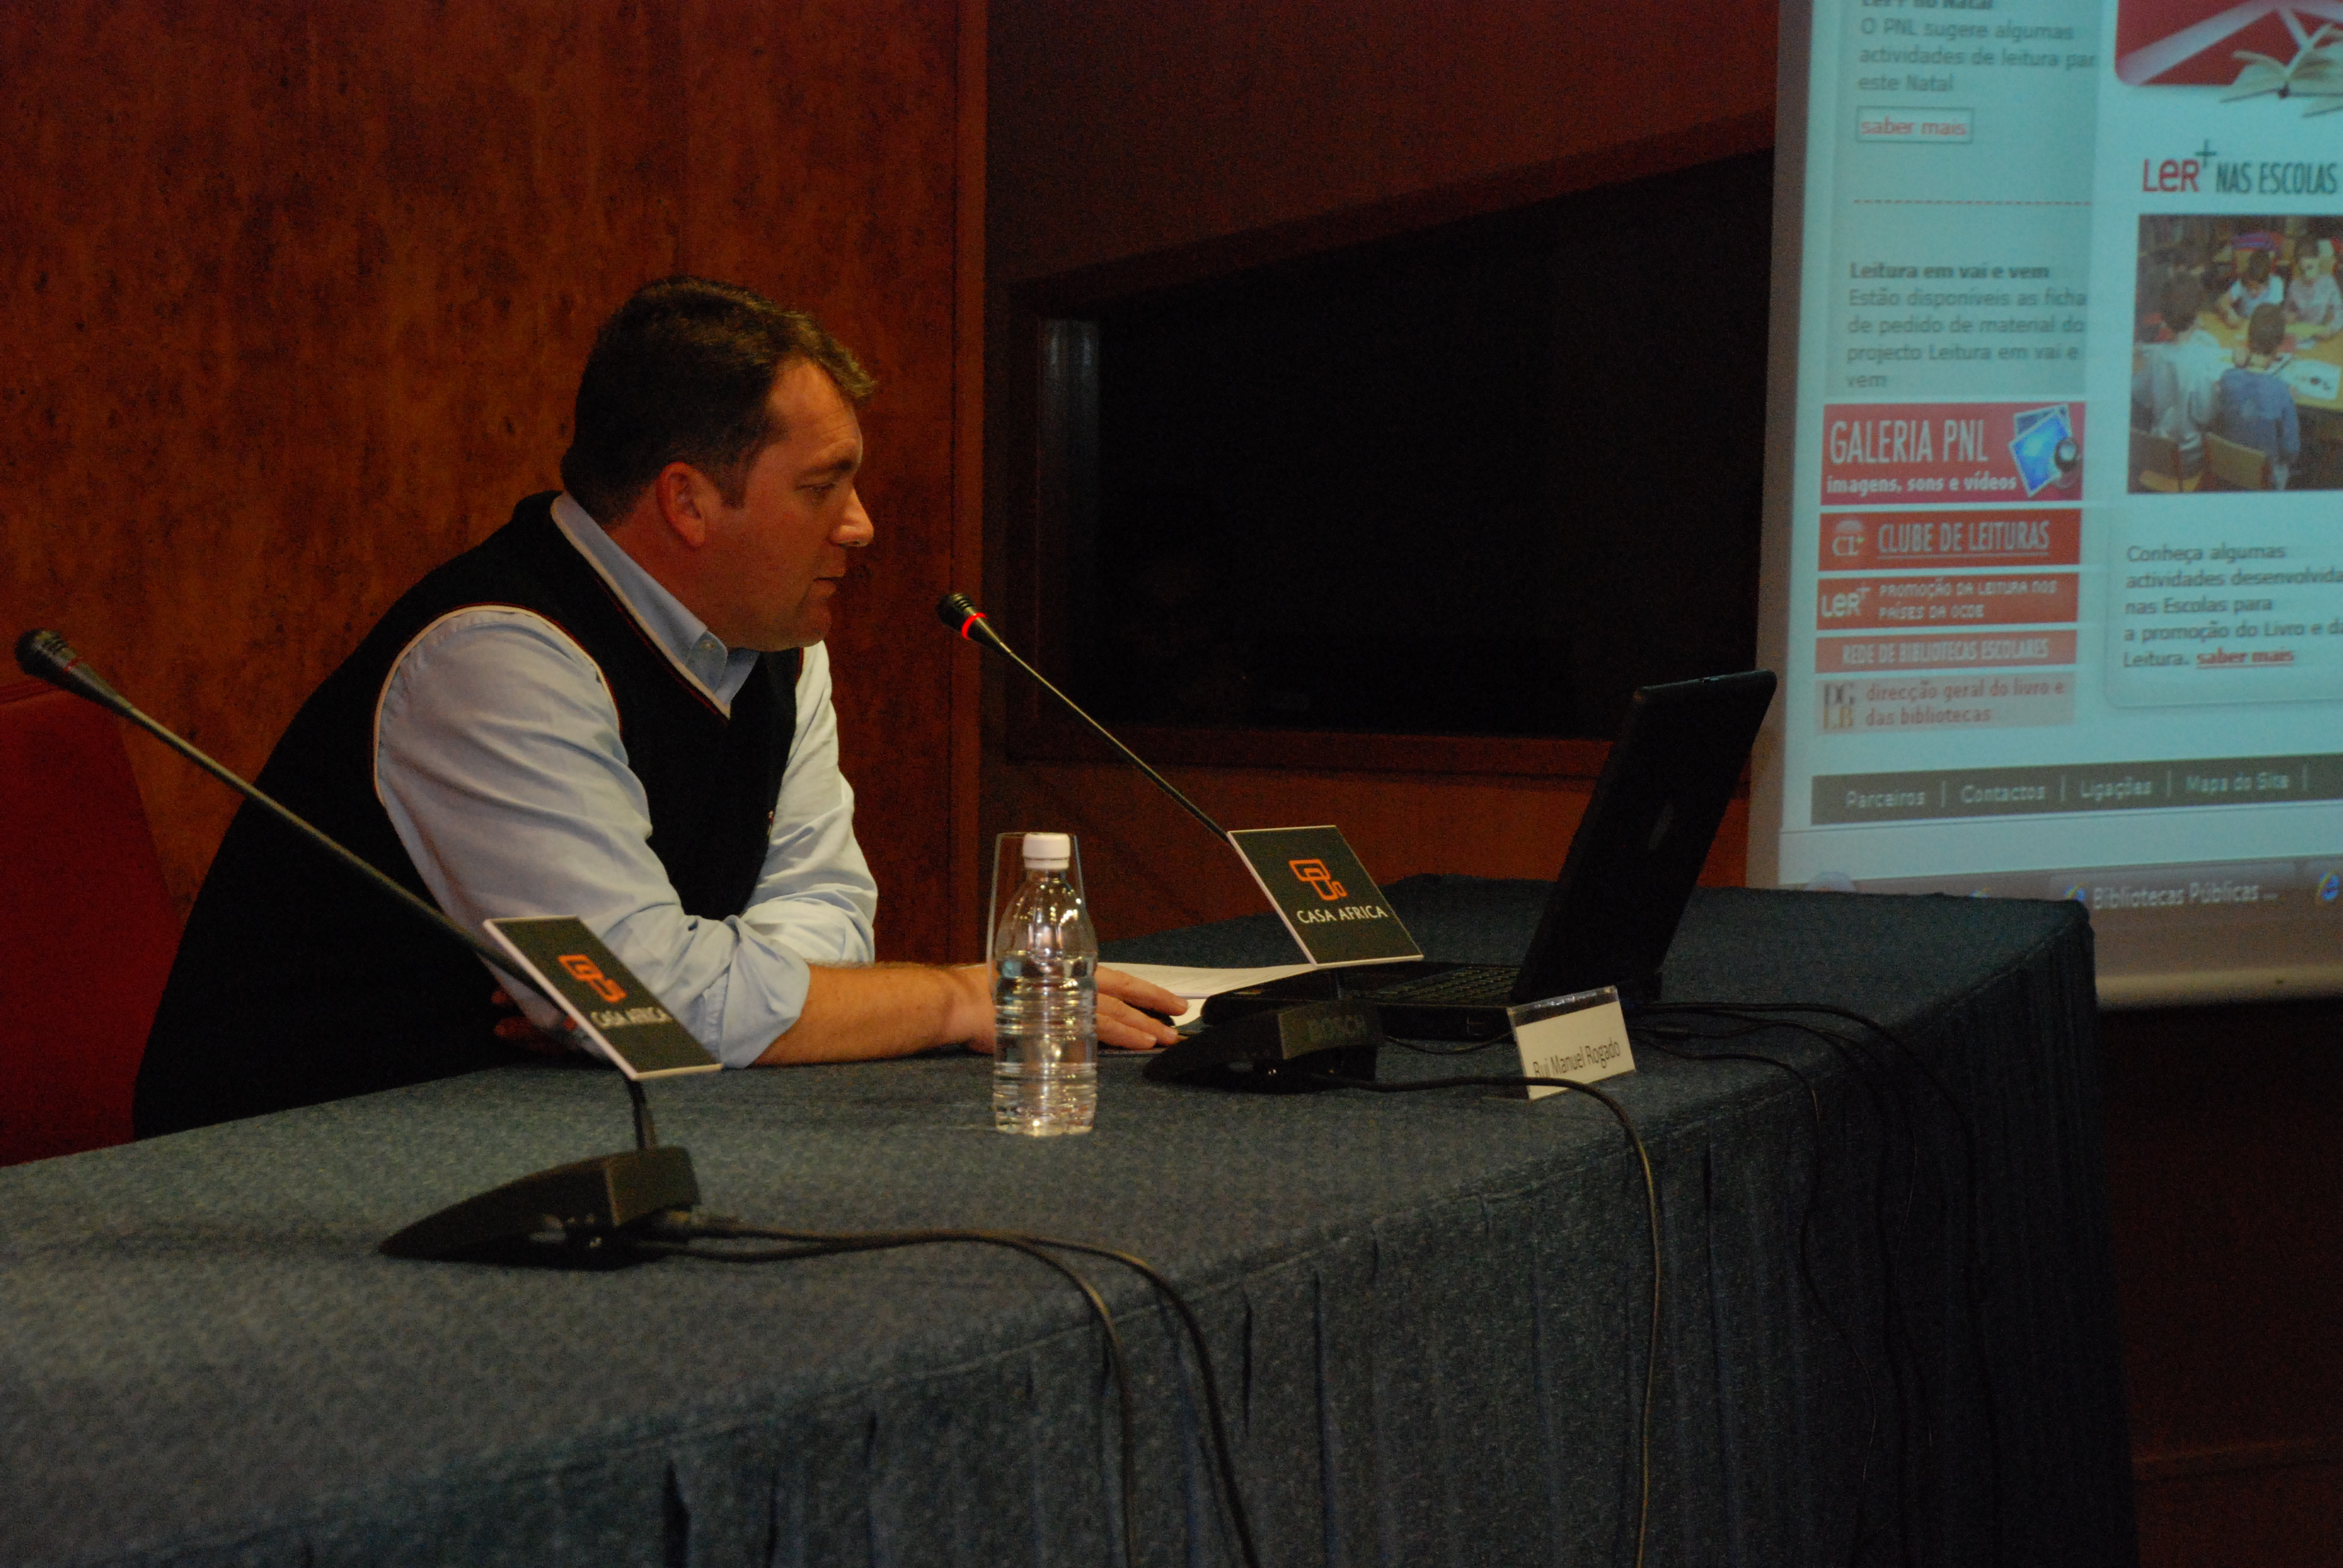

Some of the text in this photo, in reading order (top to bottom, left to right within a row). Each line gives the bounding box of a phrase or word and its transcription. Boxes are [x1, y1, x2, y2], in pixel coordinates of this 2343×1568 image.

[1861, 17, 2074, 43] O PNL sugere algumas
[1860, 44, 1964, 65] actividades
[1971, 47, 1994, 65] de
[2001, 48, 2059, 67] leitura
[1858, 74, 1954, 91] este Natal
[1860, 117, 1967, 136] saber mais
[2215, 163, 2252, 194] NAS
[2258, 162, 2338, 194] ESCOLAS
[1850, 262, 2050, 279] Leitura em vai e vem
[1849, 287, 1900, 306] Estão
[1906, 287, 2010, 310] disponíveis
[2017, 292, 2037, 306] as
[1847, 315, 2085, 336] de pedido de material do
[1846, 344, 2079, 364] projecto Leitura em vai e
[1846, 374, 1887, 388] vem
[1830, 419, 1988, 463] GALERIA PNL
[1907, 479, 1943, 492] sons
[1949, 479, 1959, 491] e
[1964, 471, 2017, 491] vídeos
[1878, 521, 2050, 553] CLUBE DE LEITURAS
[2126, 542, 2286, 565] Conheça algumas
[1879, 577, 1951, 598] PROMOÇÃO
[1978, 581, 2027, 595] LEITURA
[2126, 569, 2224, 589] actividades
[1879, 601, 1924, 619] PAÍSES
[2125, 596, 2273, 615] nas Escolas para
[2125, 629, 2135, 641] a
[2142, 619, 2229, 644] promoção
[2236, 621, 2258, 637] do
[2265, 621, 2304, 636] Livro
[2310, 624, 2322, 635] e
[1843, 639, 2049, 664] REDE DE BIBLIOTECAS ESCOLARES
[2196, 646, 2247, 665] saber
[2252, 648, 2295, 663] mais
[1867, 679, 2065, 703] direcção geral do livro e
[1866, 707, 1991, 726] das bibliotecas
[1845, 789, 1925, 809] Parceiros
[1959, 785, 2045, 803] Contactos
[2186, 775, 2228, 795] Mapa
[2233, 772, 2252, 791] do
[2092, 886, 2184, 909] Bibliotecas
[2189, 880, 2259, 904] Públicas
[1297, 906, 1388, 923] CASA AFRICA
[1550, 1046, 1585, 1076] Manuel
[1585, 1037, 1621, 1068] Rogado
